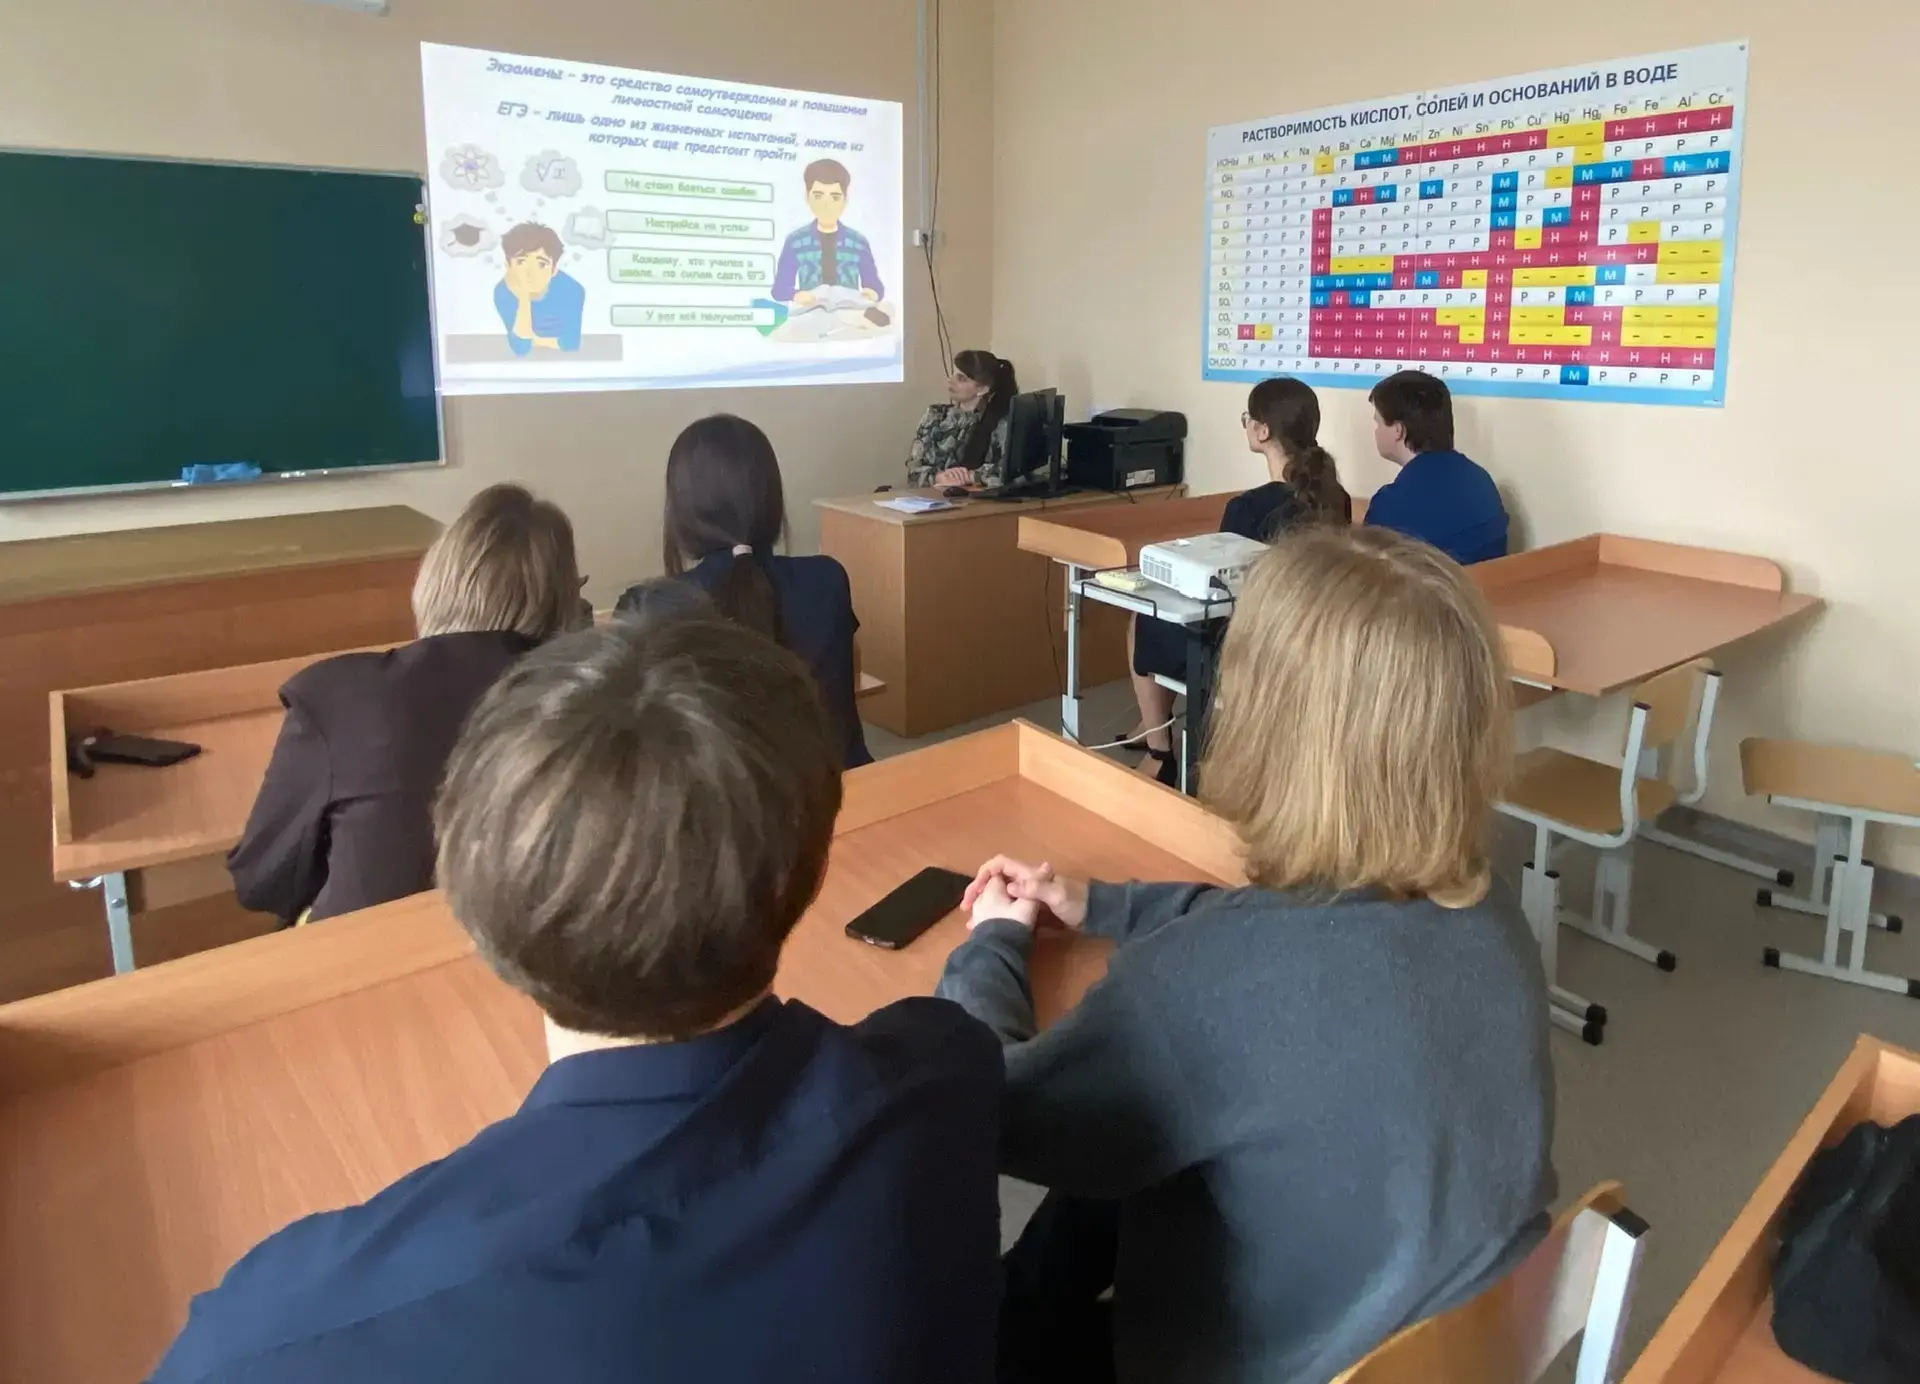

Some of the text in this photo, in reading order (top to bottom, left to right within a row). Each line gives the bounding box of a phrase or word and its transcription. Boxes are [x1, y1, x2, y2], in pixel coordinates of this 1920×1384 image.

[486, 57, 563, 80] Экзамены
[580, 73, 605, 85] это
[610, 76, 672, 93] средство
[676, 84, 787, 106] самоутверждения
[789, 99, 798, 108] и
[802, 100, 868, 116] повышения
[1242, 63, 1679, 142] РАСТВОРИМОСТЬ КИСЛОТ, СОЛЕЙ И ОСНОВАНИЙ В ВОДЕ
[497, 101, 528, 118] ЕГЭ
[546, 110, 585, 124] лишь
[590, 115, 625, 128] одно
[630, 120, 646, 130] из
[651, 122, 724, 139] жизненных
[804, 138, 847, 151] многие
[850, 143, 864, 152] из
[612, 94, 772, 122] личностной самооценки
[588, 133, 797, 161] которых еще предстоит пройти
[624, 177, 639, 188] Не
